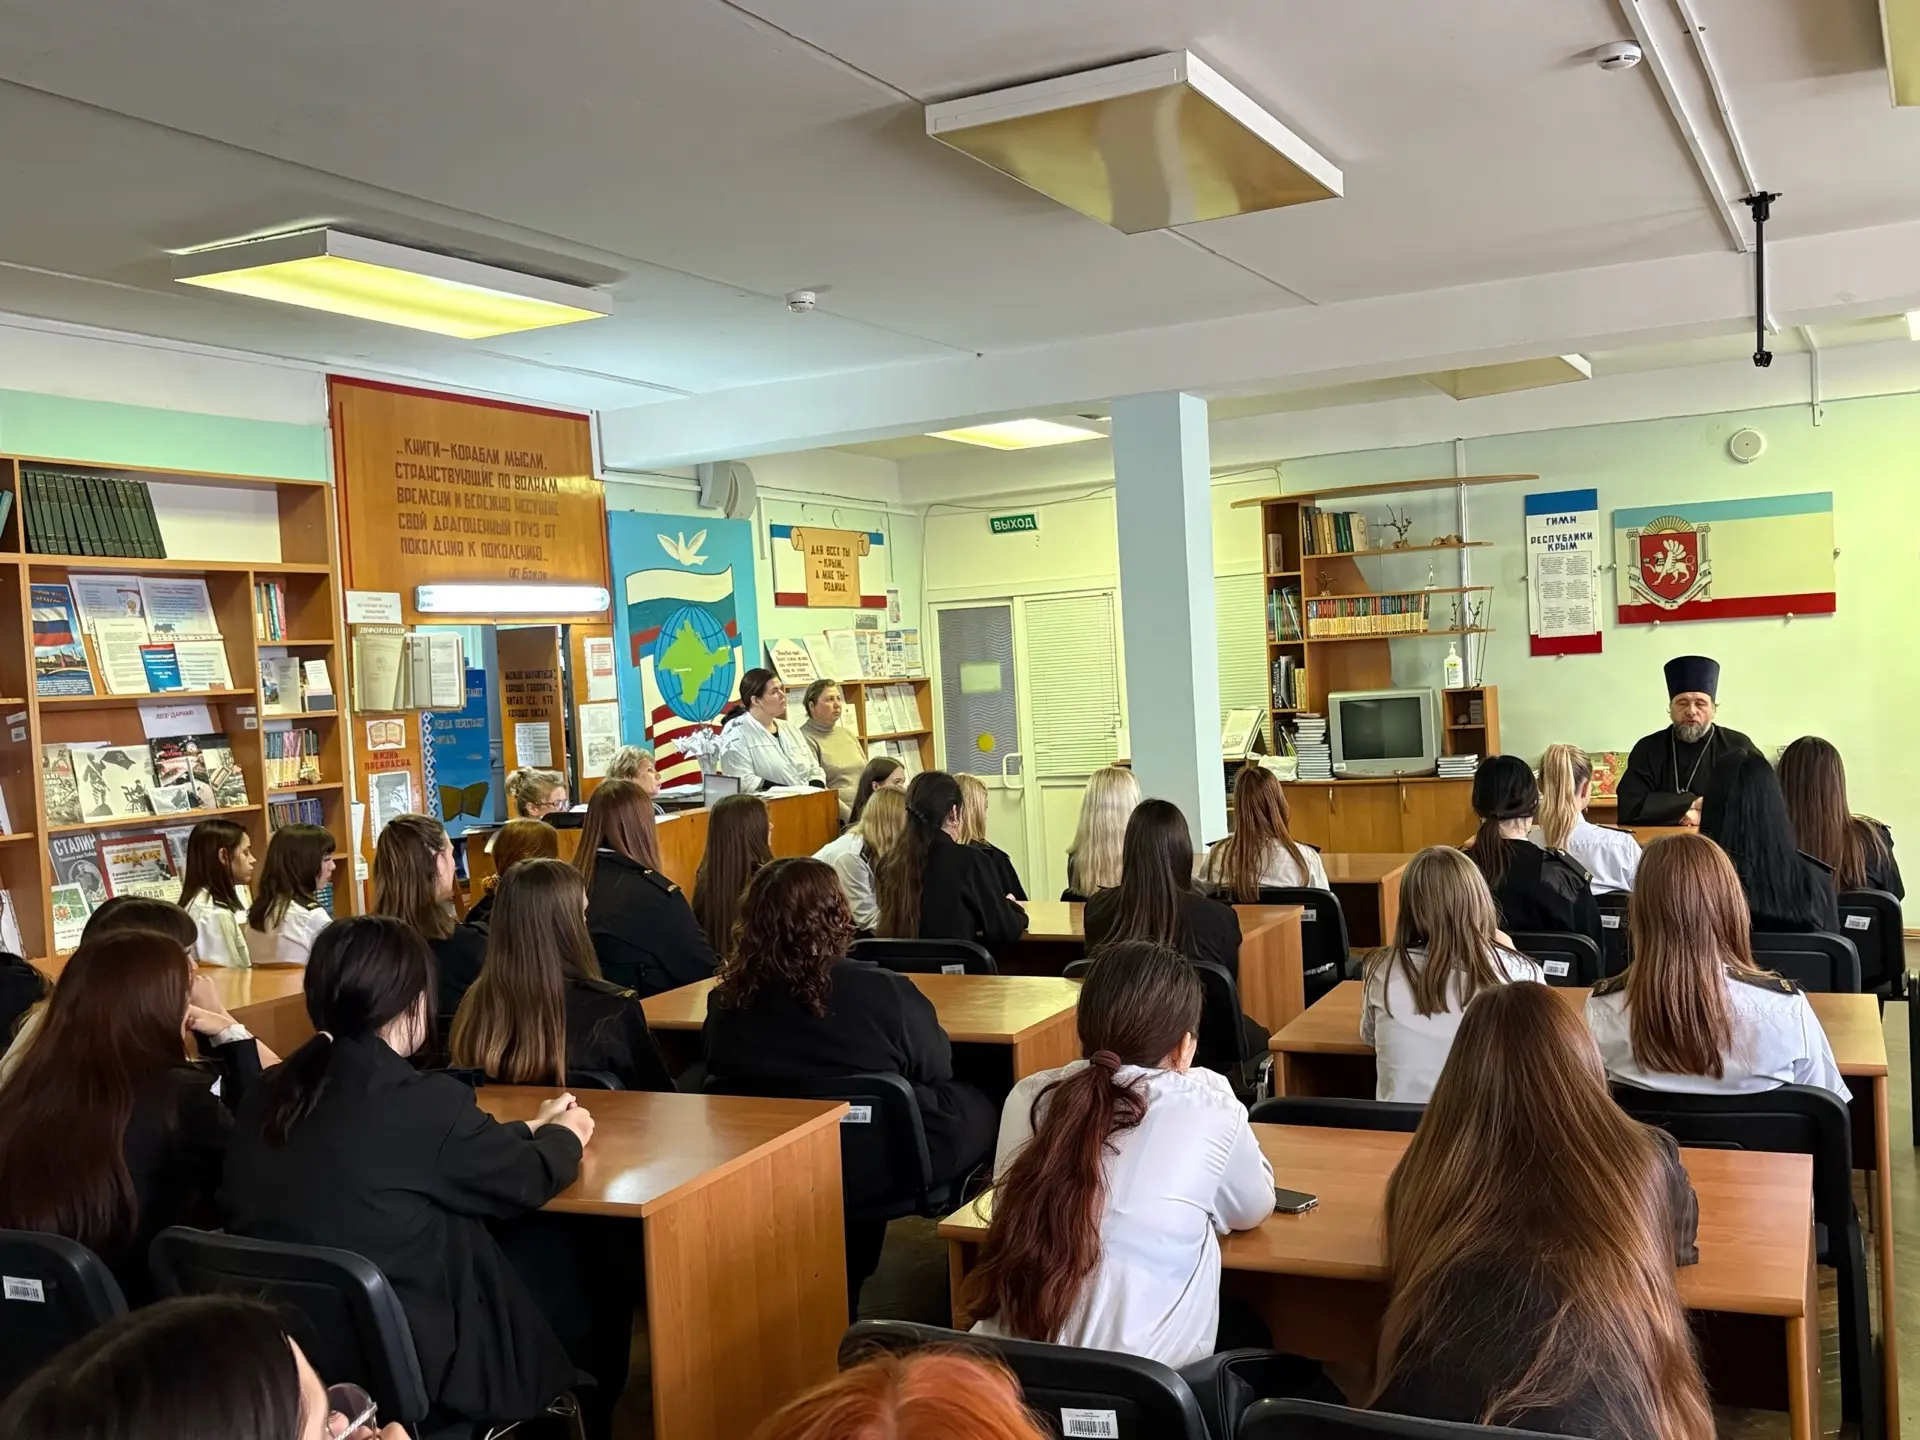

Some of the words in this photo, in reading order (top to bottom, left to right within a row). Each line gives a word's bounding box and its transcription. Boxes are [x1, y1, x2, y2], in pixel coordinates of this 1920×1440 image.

[395, 461, 494, 488] СТРАНСТВУЮЩИЕ
[498, 472, 511, 489] ПО
[515, 474, 559, 494] ВОЛНАМ
[397, 486, 451, 507] ВРЕМЕНИ
[454, 491, 462, 509] И
[398, 511, 427, 531] СВОЙ
[433, 515, 511, 537] ДРАГОЦЕННЫЙ
[514, 520, 540, 538] ГРУЗ
[544, 523, 556, 539] ОТ
[993, 517, 1035, 531] ВЫХОД
[1546, 515, 1577, 526] ГИМН
[1530, 531, 1593, 545] РЕСПУБЛИКИ
[400, 537, 464, 557] ПОКОЛЕНИЯ
[468, 541, 477, 557] К
[1547, 541, 1578, 552] КРЫМ
[364, 758, 411, 771] ПРЕКРАСНА
